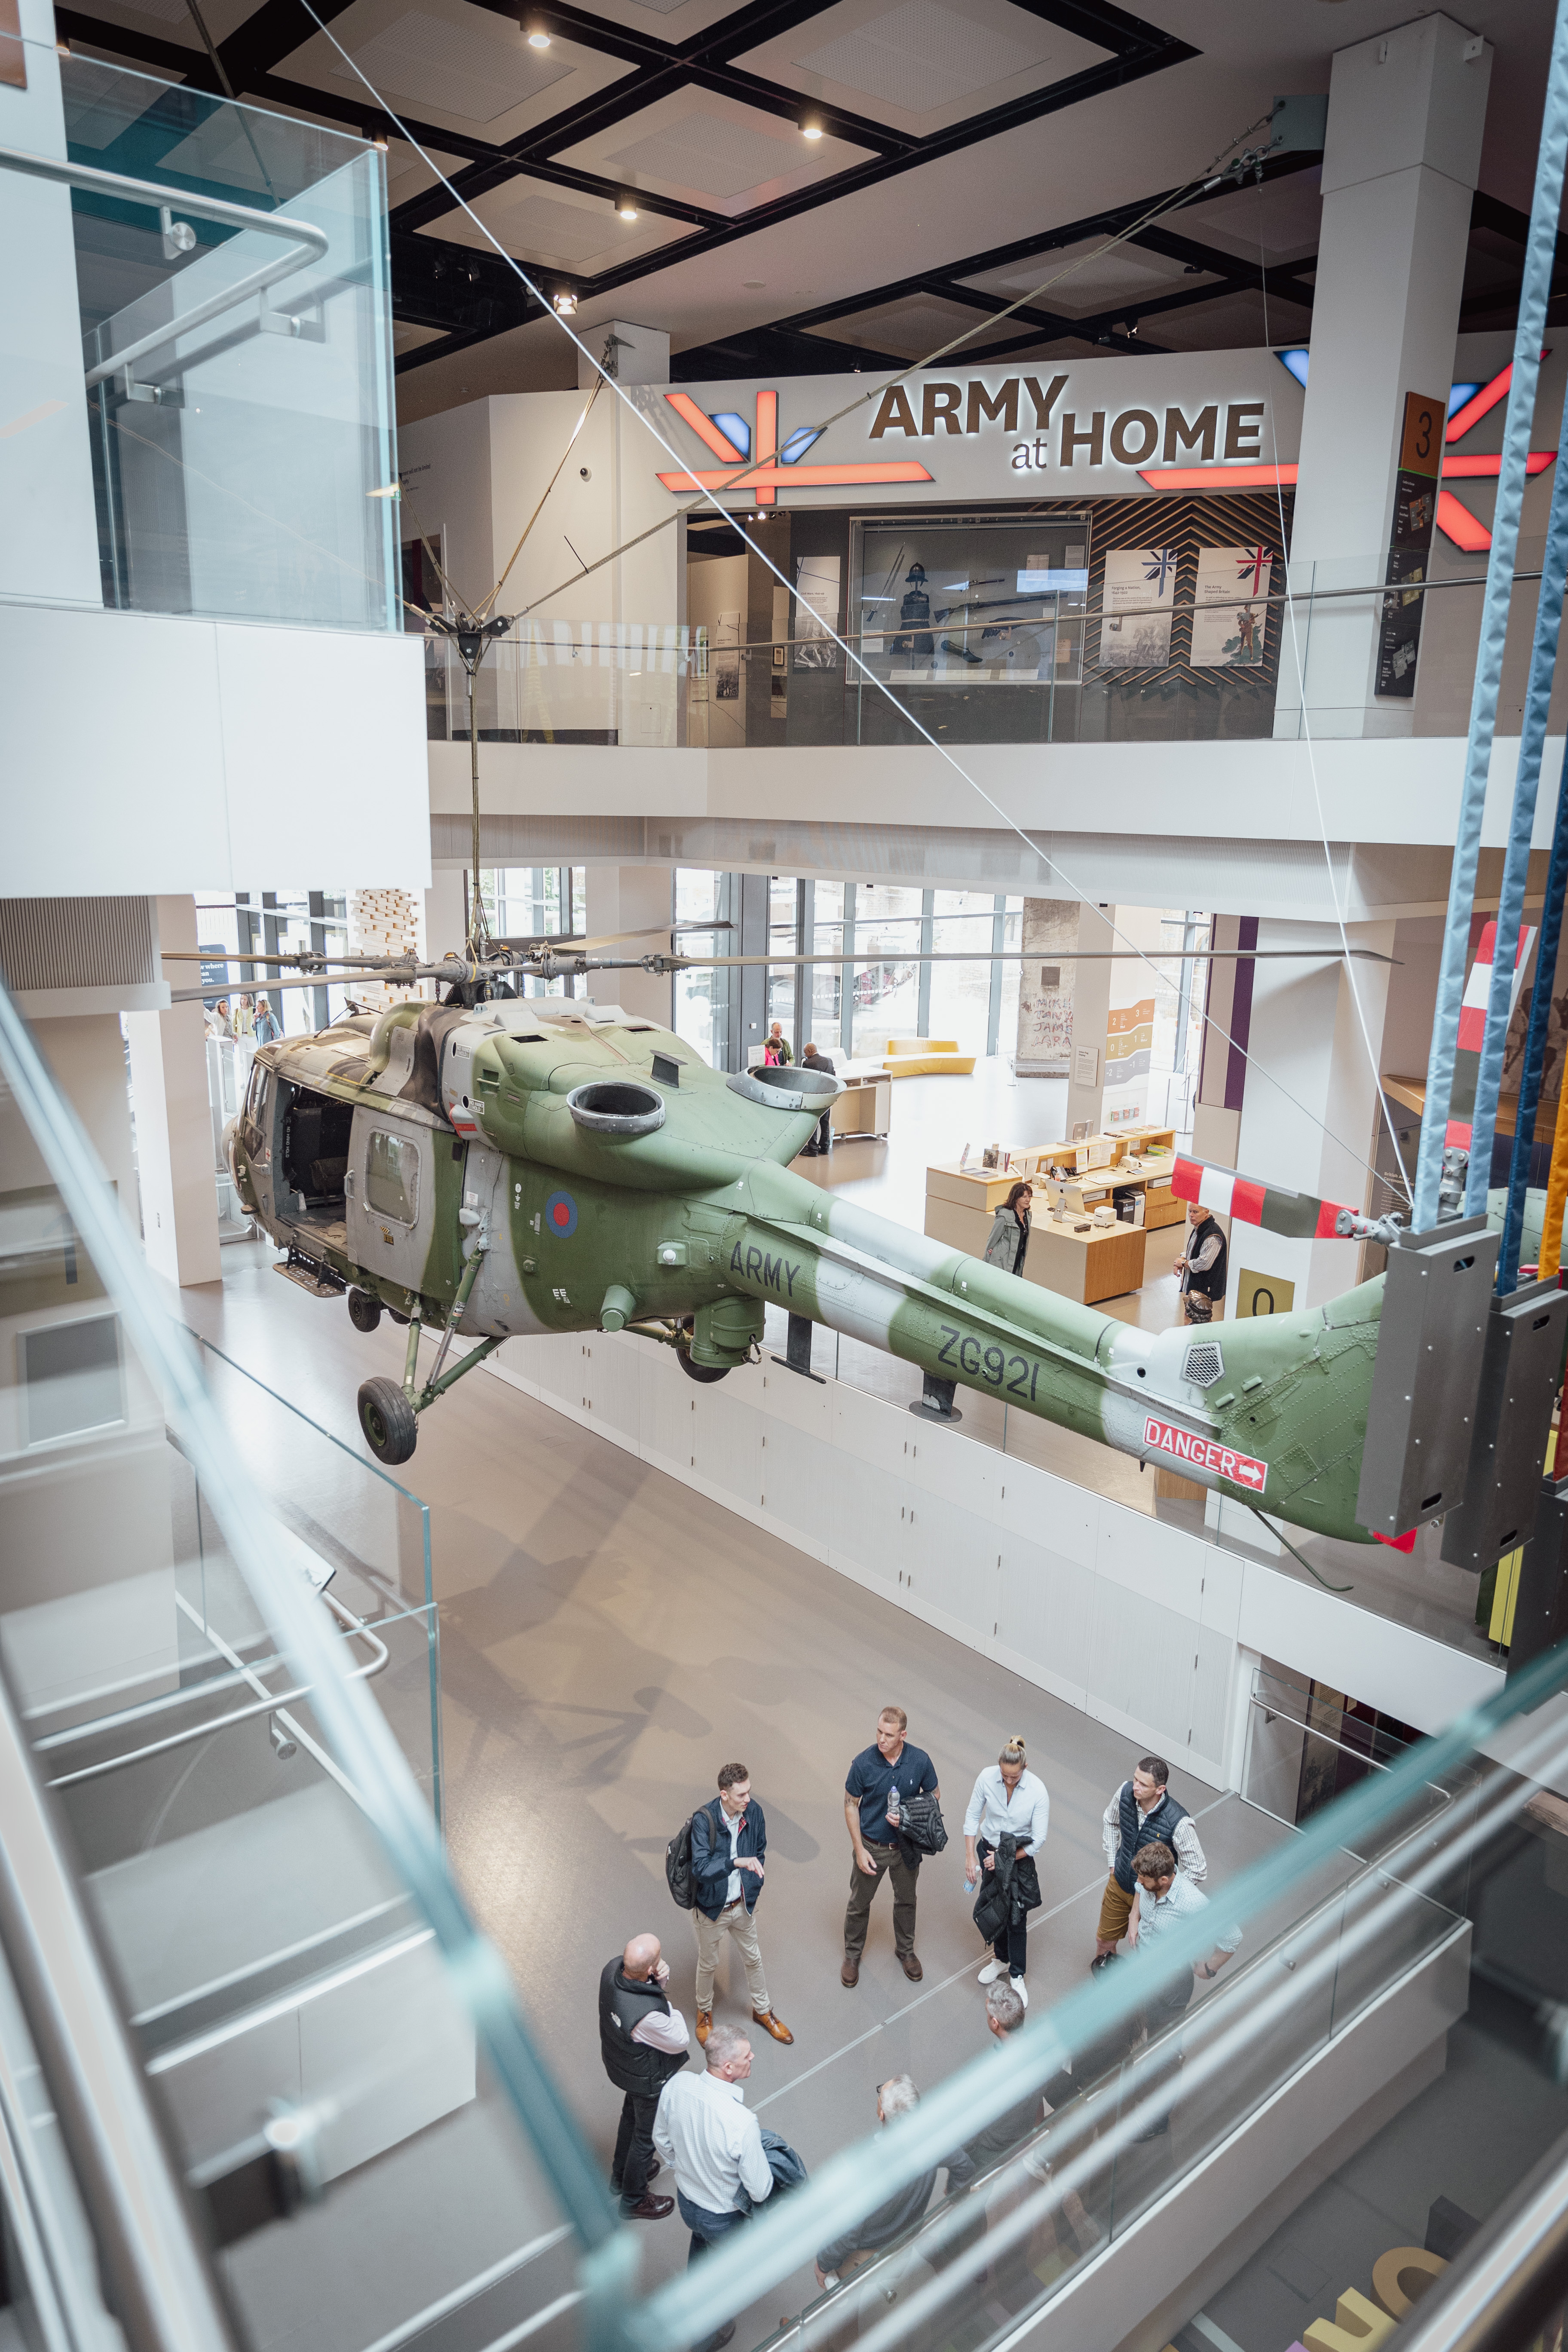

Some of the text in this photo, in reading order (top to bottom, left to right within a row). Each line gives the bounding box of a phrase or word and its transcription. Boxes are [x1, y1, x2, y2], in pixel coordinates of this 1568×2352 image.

[869, 375, 1069, 438] ARMY
[1011, 403, 1265, 469] at HOME
[1416, 411, 1433, 459] 3
[1384, 1177, 1406, 1185] Ceremonia
[552, 1289, 567, 1297] EE
[731, 1240, 801, 1297] ARMY
[1252, 1288, 1274, 1317] 0
[937, 1325, 1039, 1402] ZG921
[1158, 1401, 1173, 1412] HAND
[1174, 1409, 1190, 1419] HOLD
[1145, 1420, 1236, 1478] DANGER
